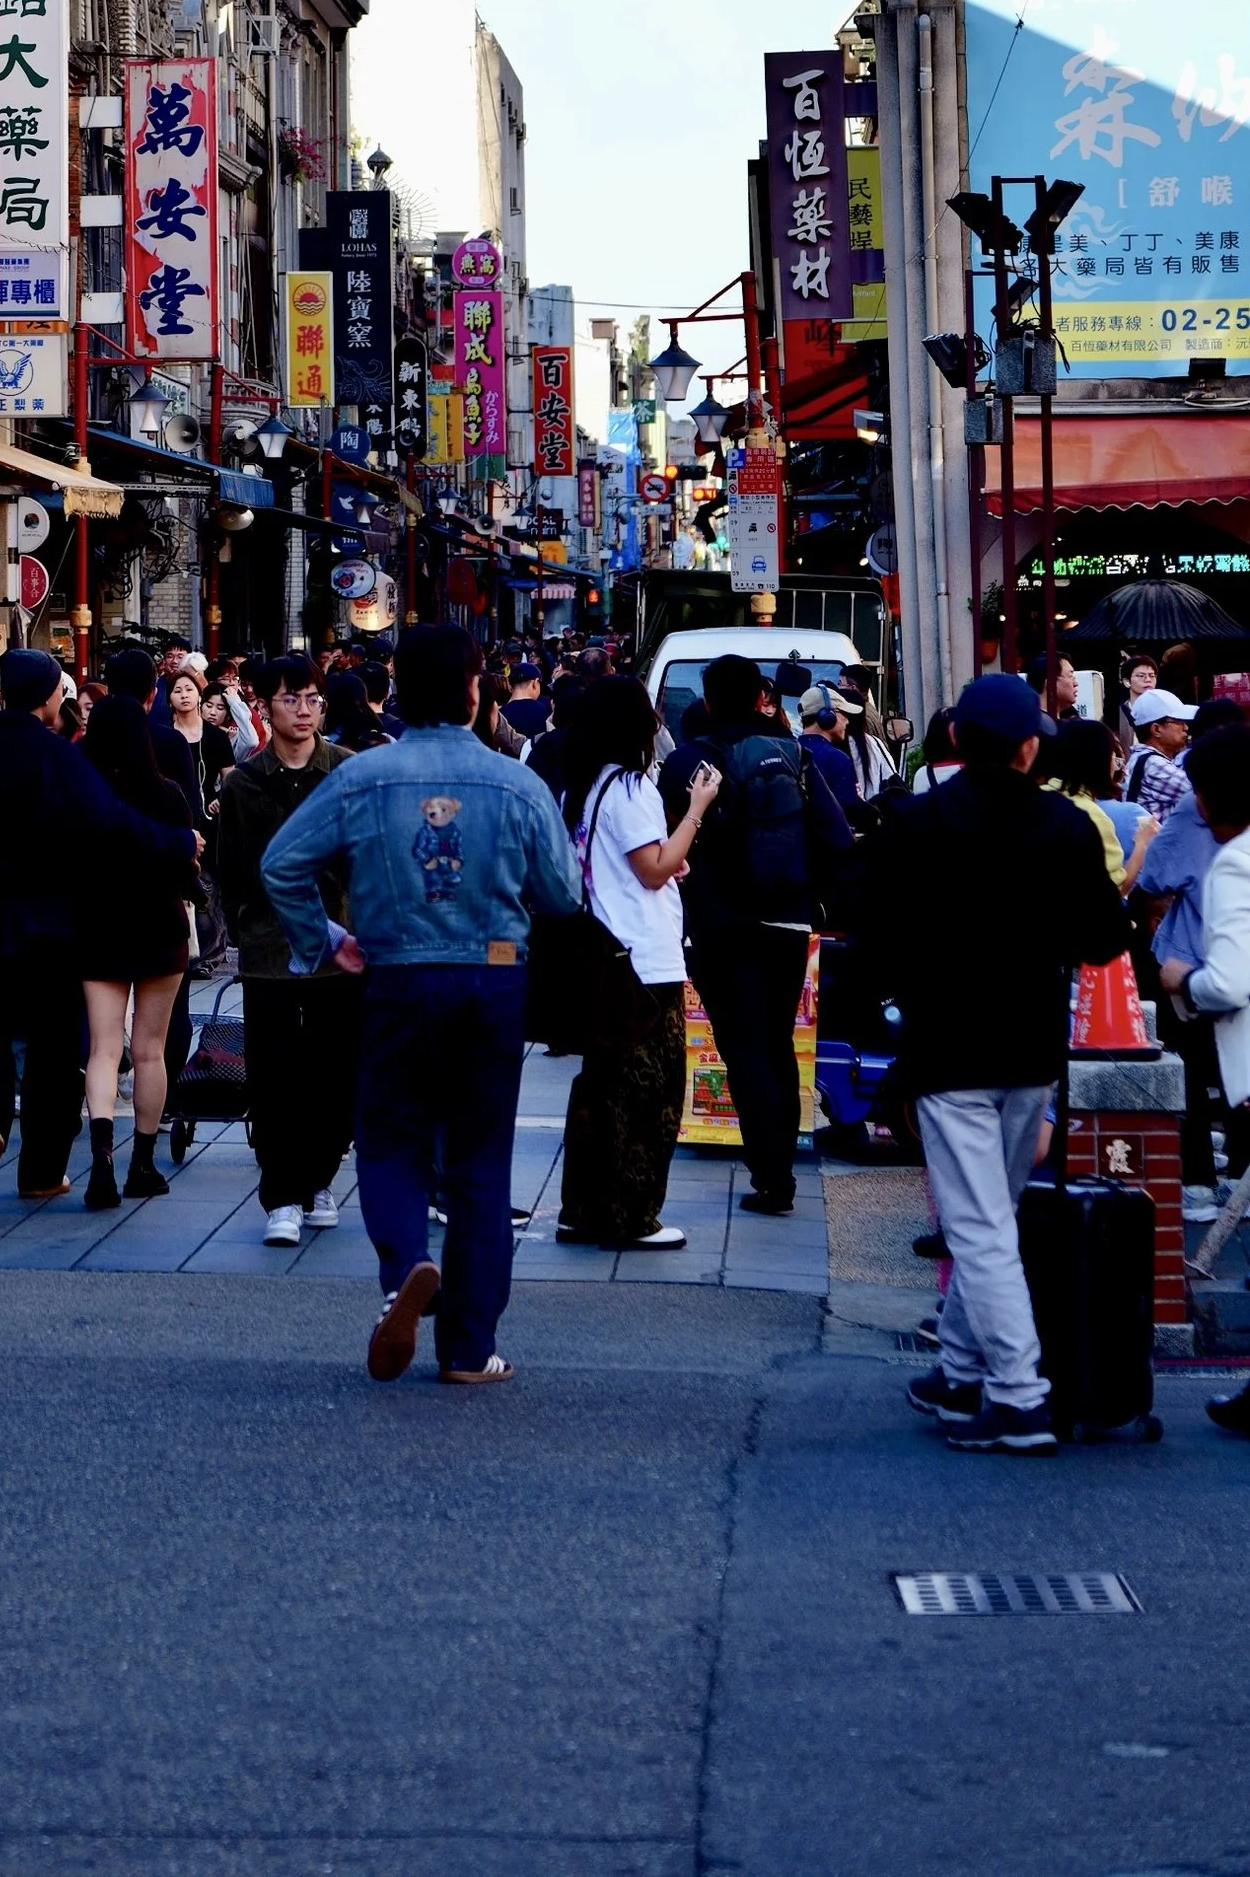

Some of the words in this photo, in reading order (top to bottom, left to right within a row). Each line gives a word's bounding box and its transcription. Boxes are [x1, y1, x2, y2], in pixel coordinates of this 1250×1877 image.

[135, 82, 207, 336] 萬安堂
[341, 243, 377, 252] LOHAS
[347, 270, 372, 349] 陸寶窯
[297, 324, 325, 399] 聯通
[340, 431, 359, 450] 陶
[485, 389, 500, 444] からすみ
[537, 354, 572, 471] 百安堂
